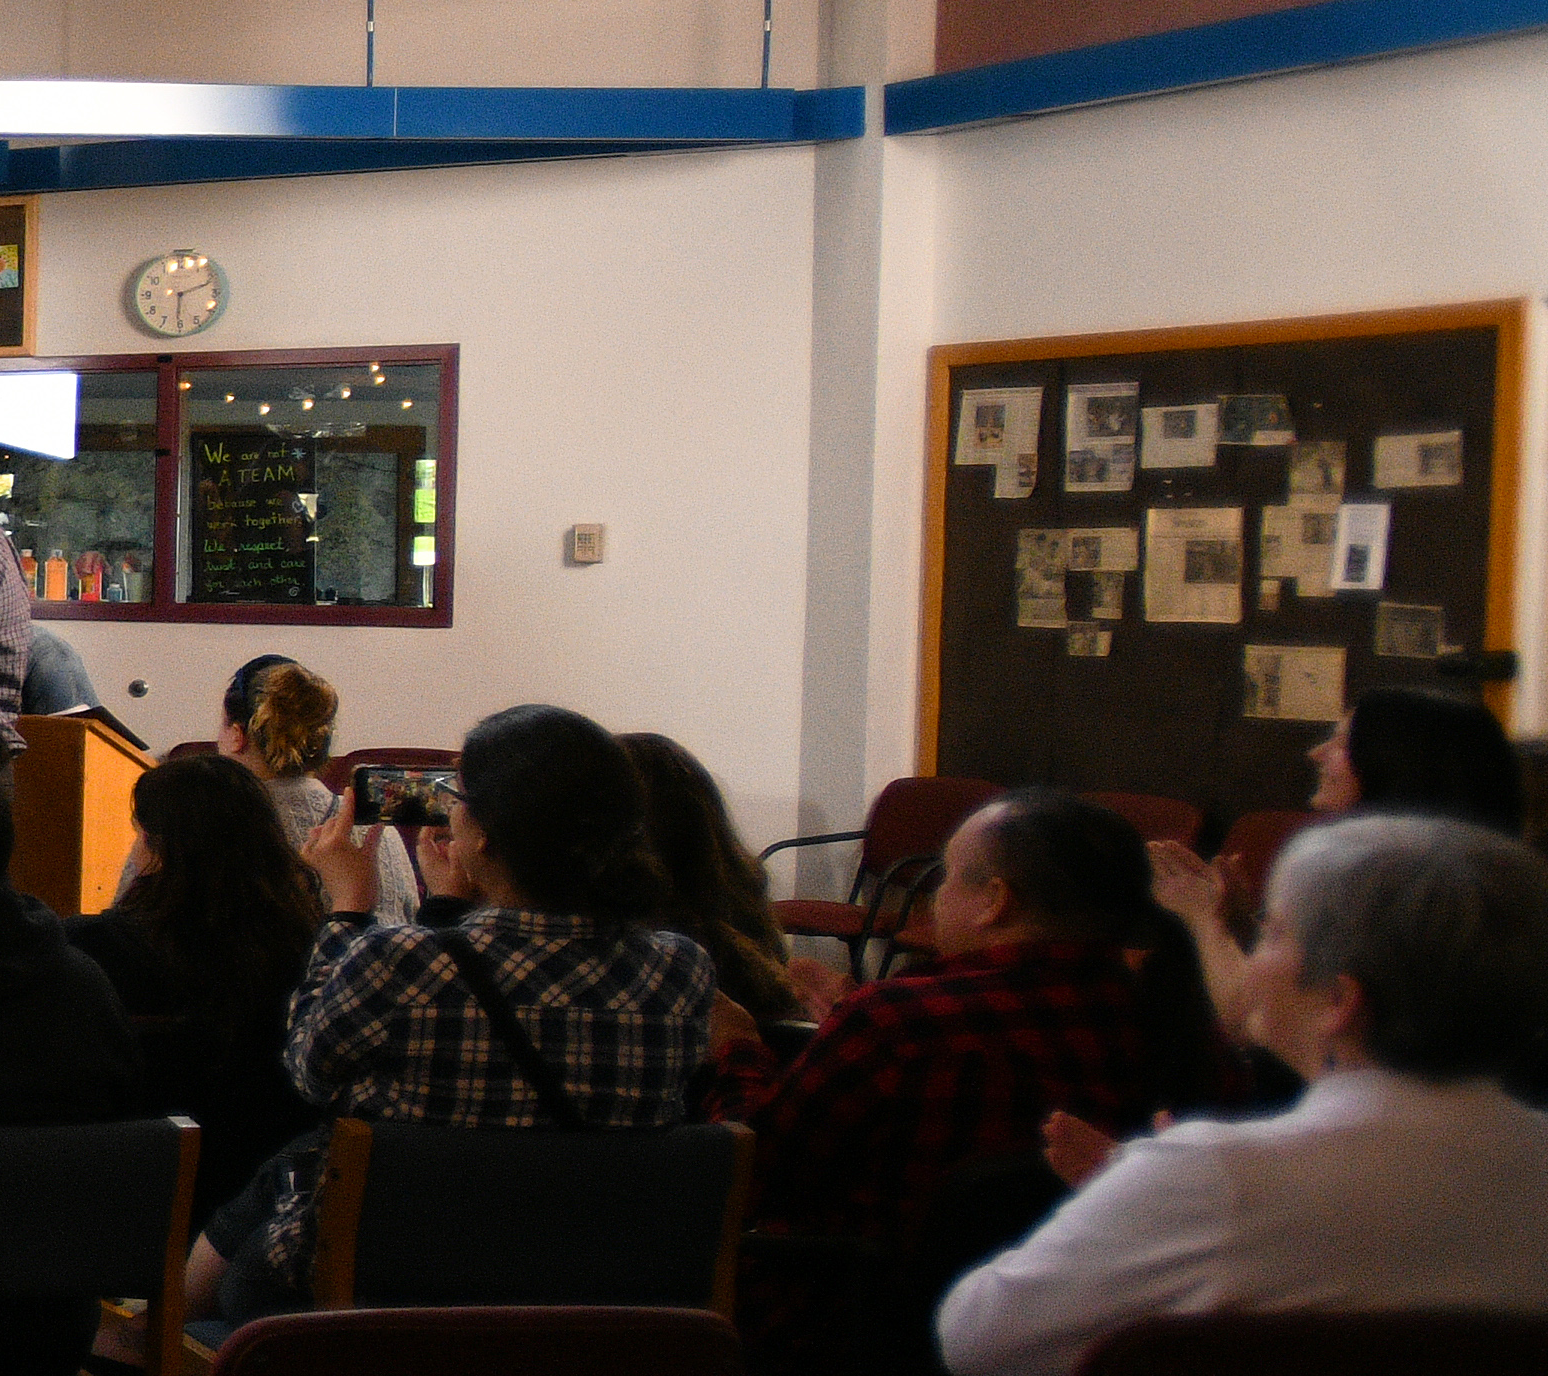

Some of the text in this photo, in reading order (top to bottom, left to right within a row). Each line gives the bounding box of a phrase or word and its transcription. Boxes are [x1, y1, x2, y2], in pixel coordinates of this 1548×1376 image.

[150, 276, 160, 285] 10
[144, 290, 152, 300] 9
[149, 306, 156, 315] 8
[161, 316, 168, 326] 7
[176, 319, 184, 328] 6
[193, 315, 200, 325] 5
[204, 442, 288, 463] We are not
[218, 465, 295, 486] A TEAM
[207, 495, 282, 510] because we
[204, 539, 226, 553] We
[248, 558, 274, 570] and
[280, 560, 306, 568] care
